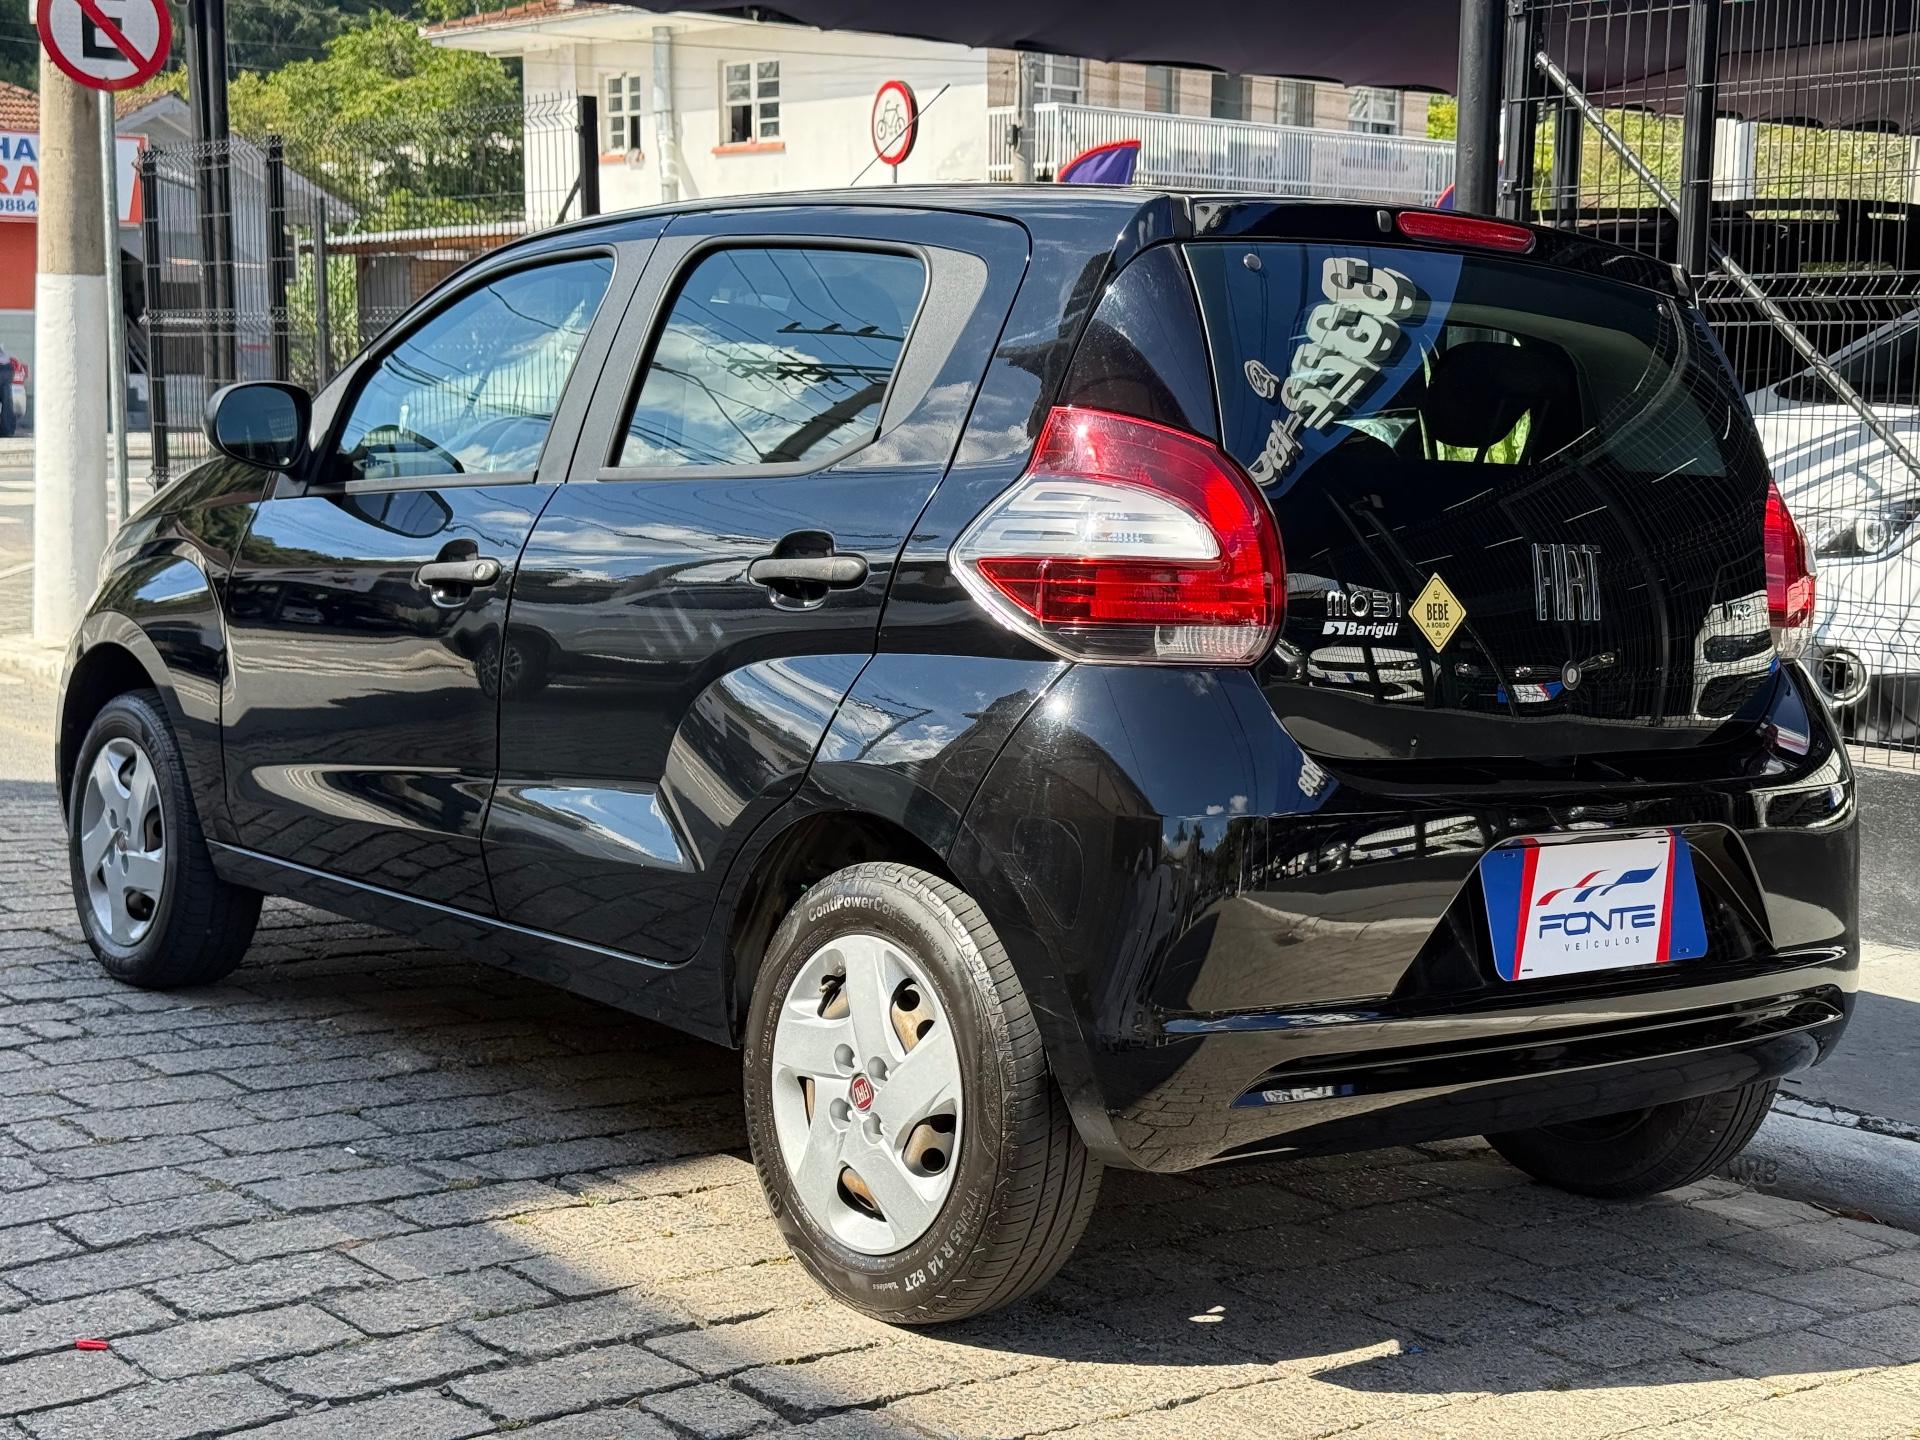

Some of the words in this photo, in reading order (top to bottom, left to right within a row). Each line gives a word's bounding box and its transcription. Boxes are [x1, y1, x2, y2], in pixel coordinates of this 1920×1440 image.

[1531, 543, 1601, 621] FIAT
[1345, 621, 1399, 639] Barigüi
[1539, 904, 1656, 939] FONTE
[1564, 936, 1640, 952] VEÍCULOS
[927, 1254, 944, 1276] 14
[904, 1268, 927, 1292] 82T
